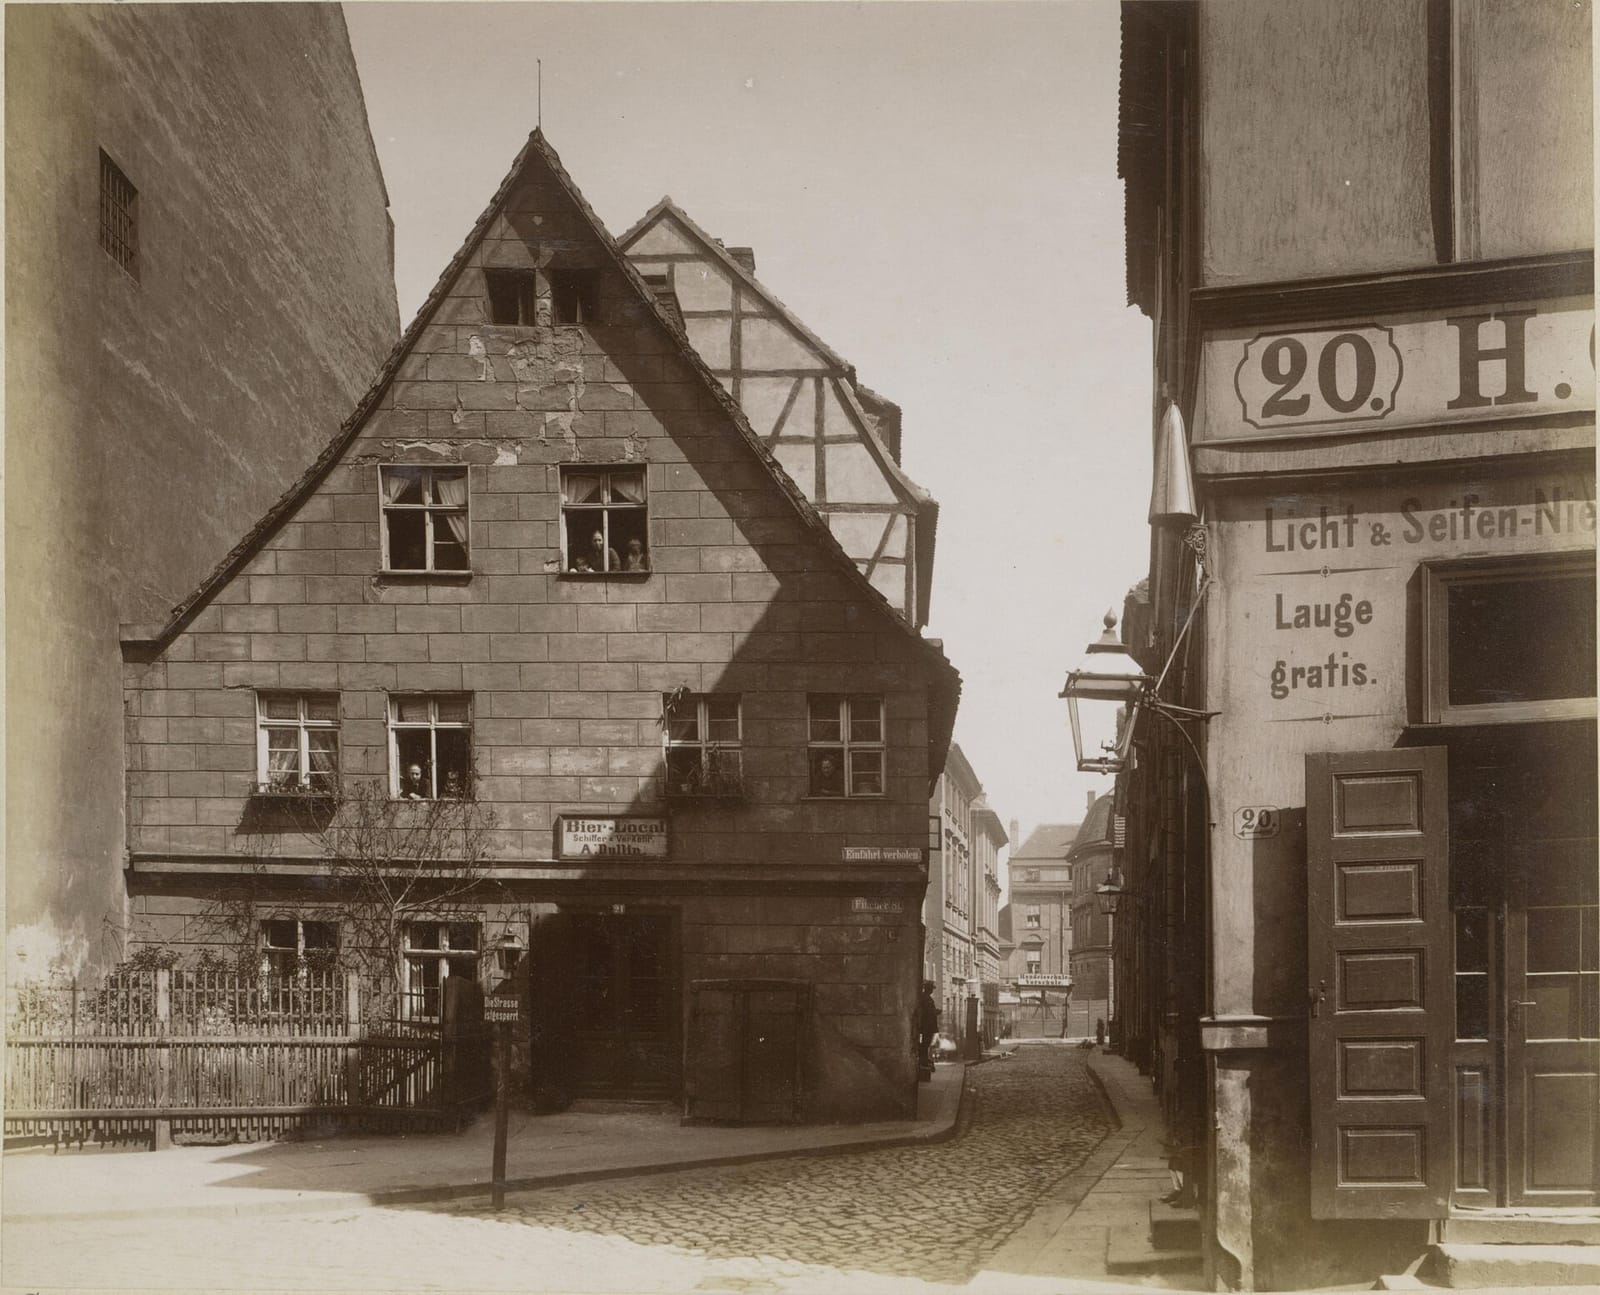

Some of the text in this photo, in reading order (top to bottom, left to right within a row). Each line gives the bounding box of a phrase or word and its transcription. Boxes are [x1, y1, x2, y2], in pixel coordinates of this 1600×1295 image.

[1261, 333, 1385, 419] 20.
[1446, 308, 1572, 410] H.
[1265, 504, 1359, 552] Licht
[1370, 522, 1391, 546] &
[1275, 593, 1373, 637] Lauge
[1271, 652, 1377, 700] gratis.
